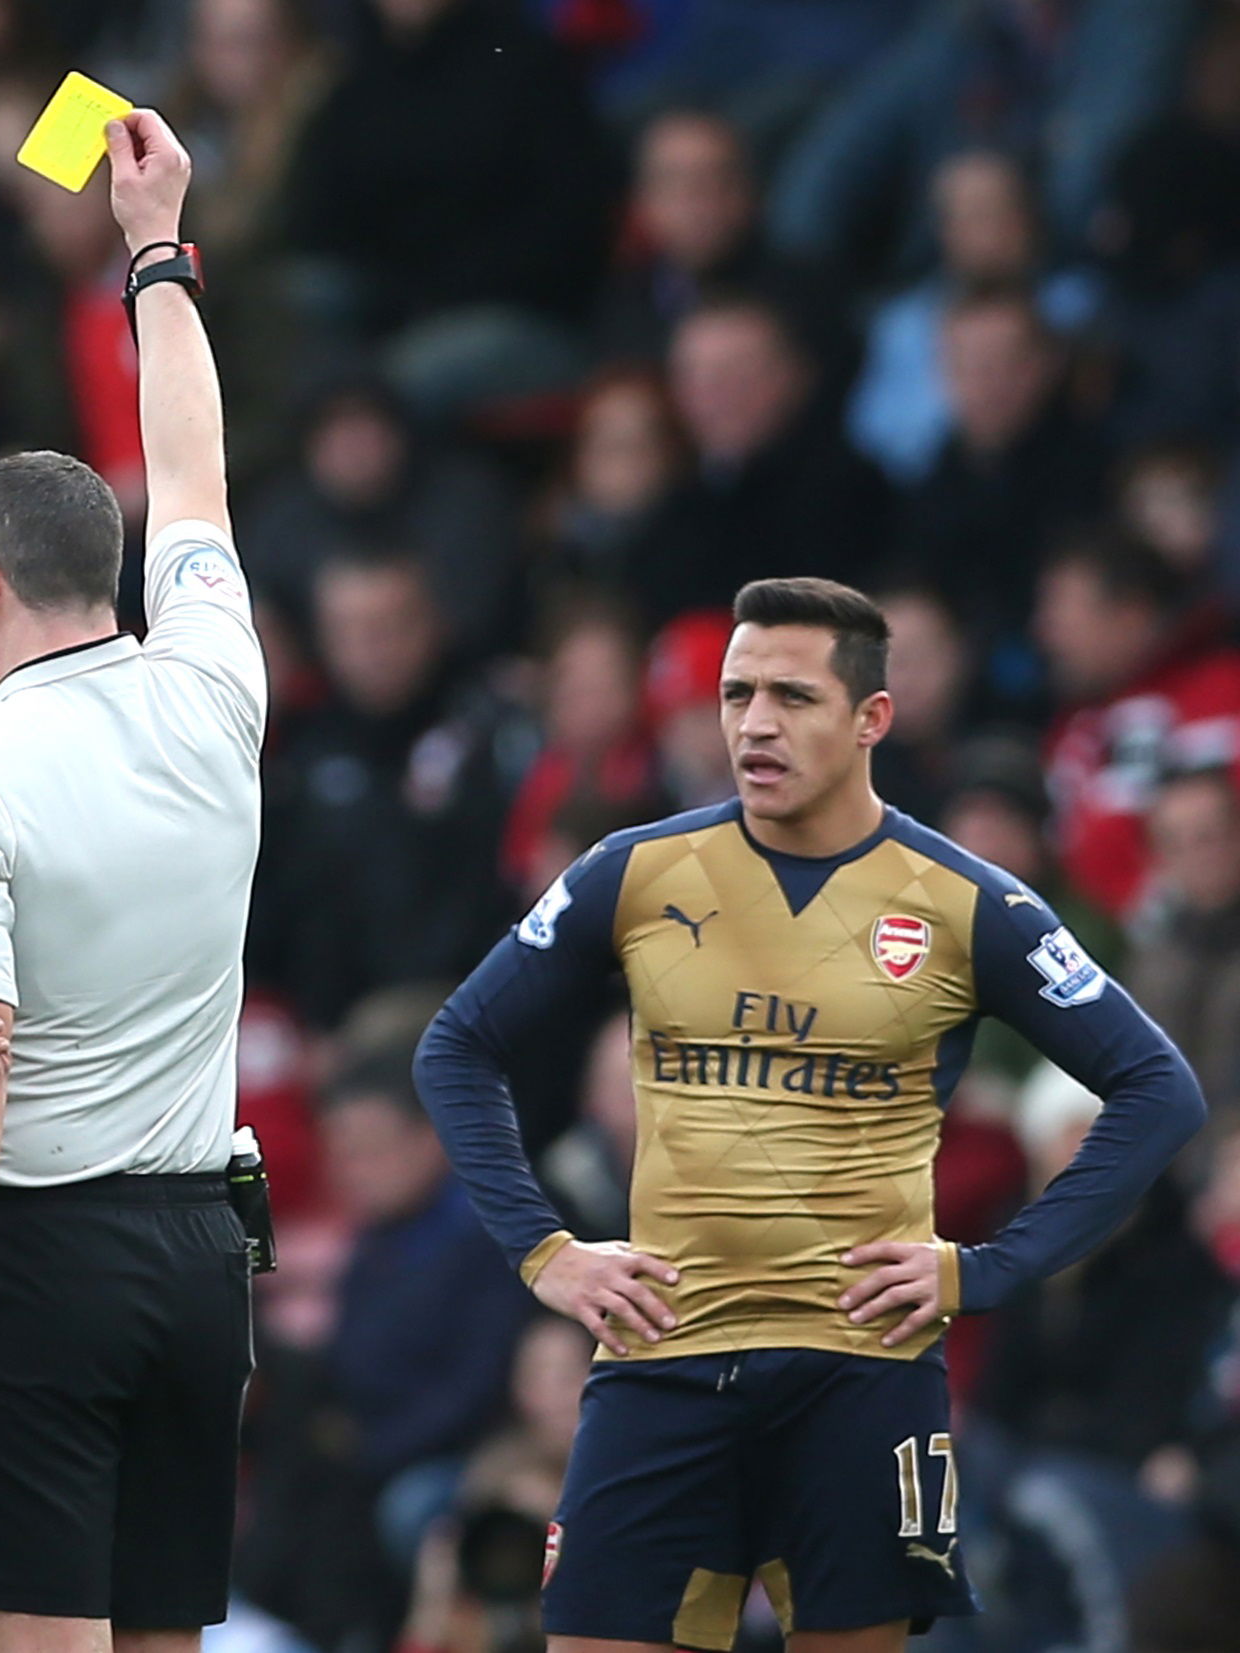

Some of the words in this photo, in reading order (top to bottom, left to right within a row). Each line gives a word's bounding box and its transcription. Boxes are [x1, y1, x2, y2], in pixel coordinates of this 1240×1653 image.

[732, 991, 818, 1042] Fly
[648, 1030, 901, 1101] Emirates
[893, 1432, 959, 1537] 17
